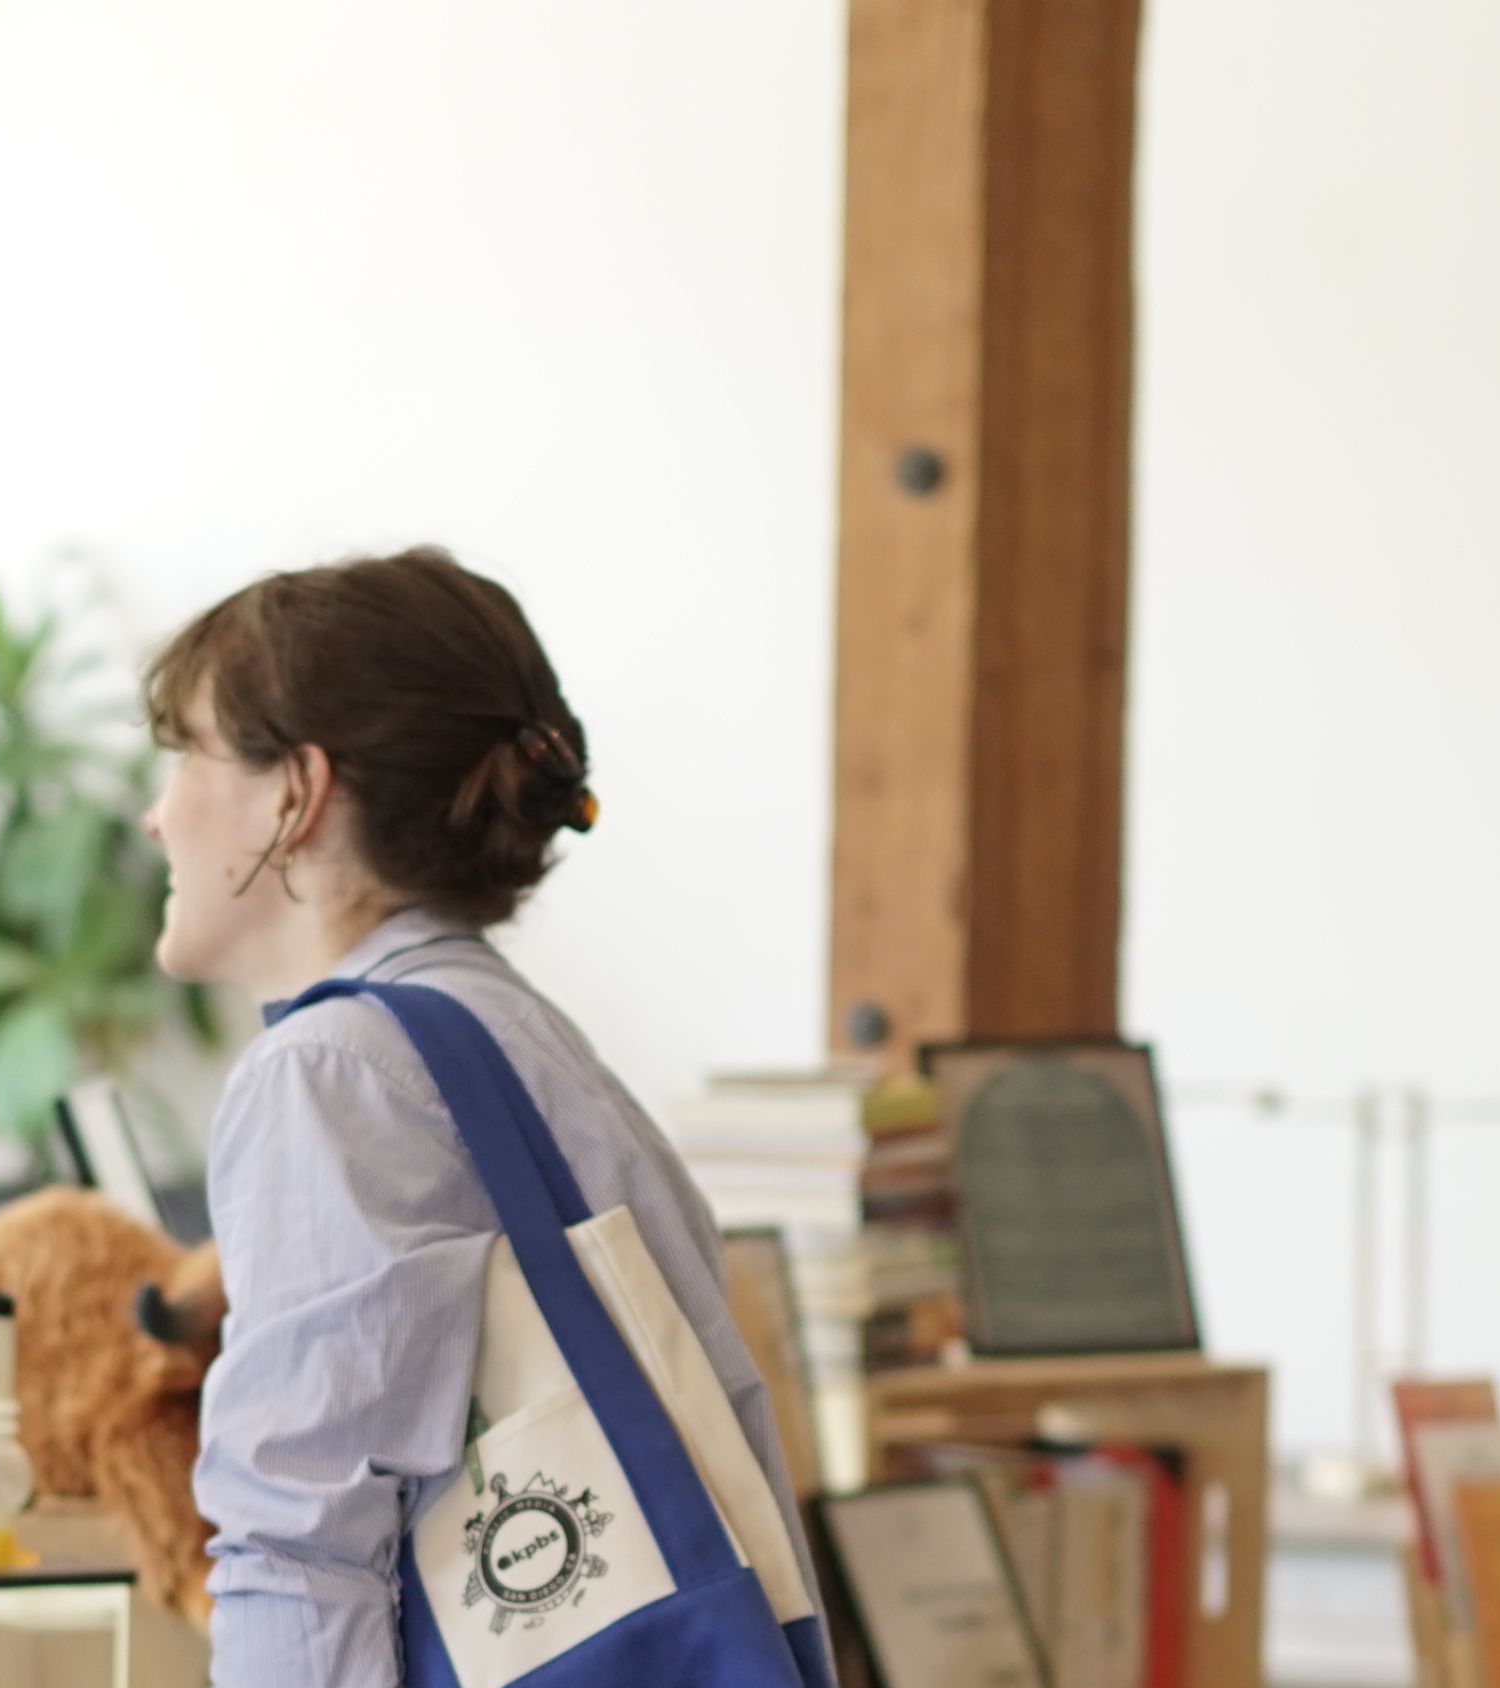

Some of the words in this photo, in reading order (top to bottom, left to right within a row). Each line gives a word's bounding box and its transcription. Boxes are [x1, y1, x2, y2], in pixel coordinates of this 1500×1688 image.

[515, 1500, 556, 1513] MEDIA
[511, 1530, 560, 1562] kpbs
[503, 1591, 527, 1602] SAN
